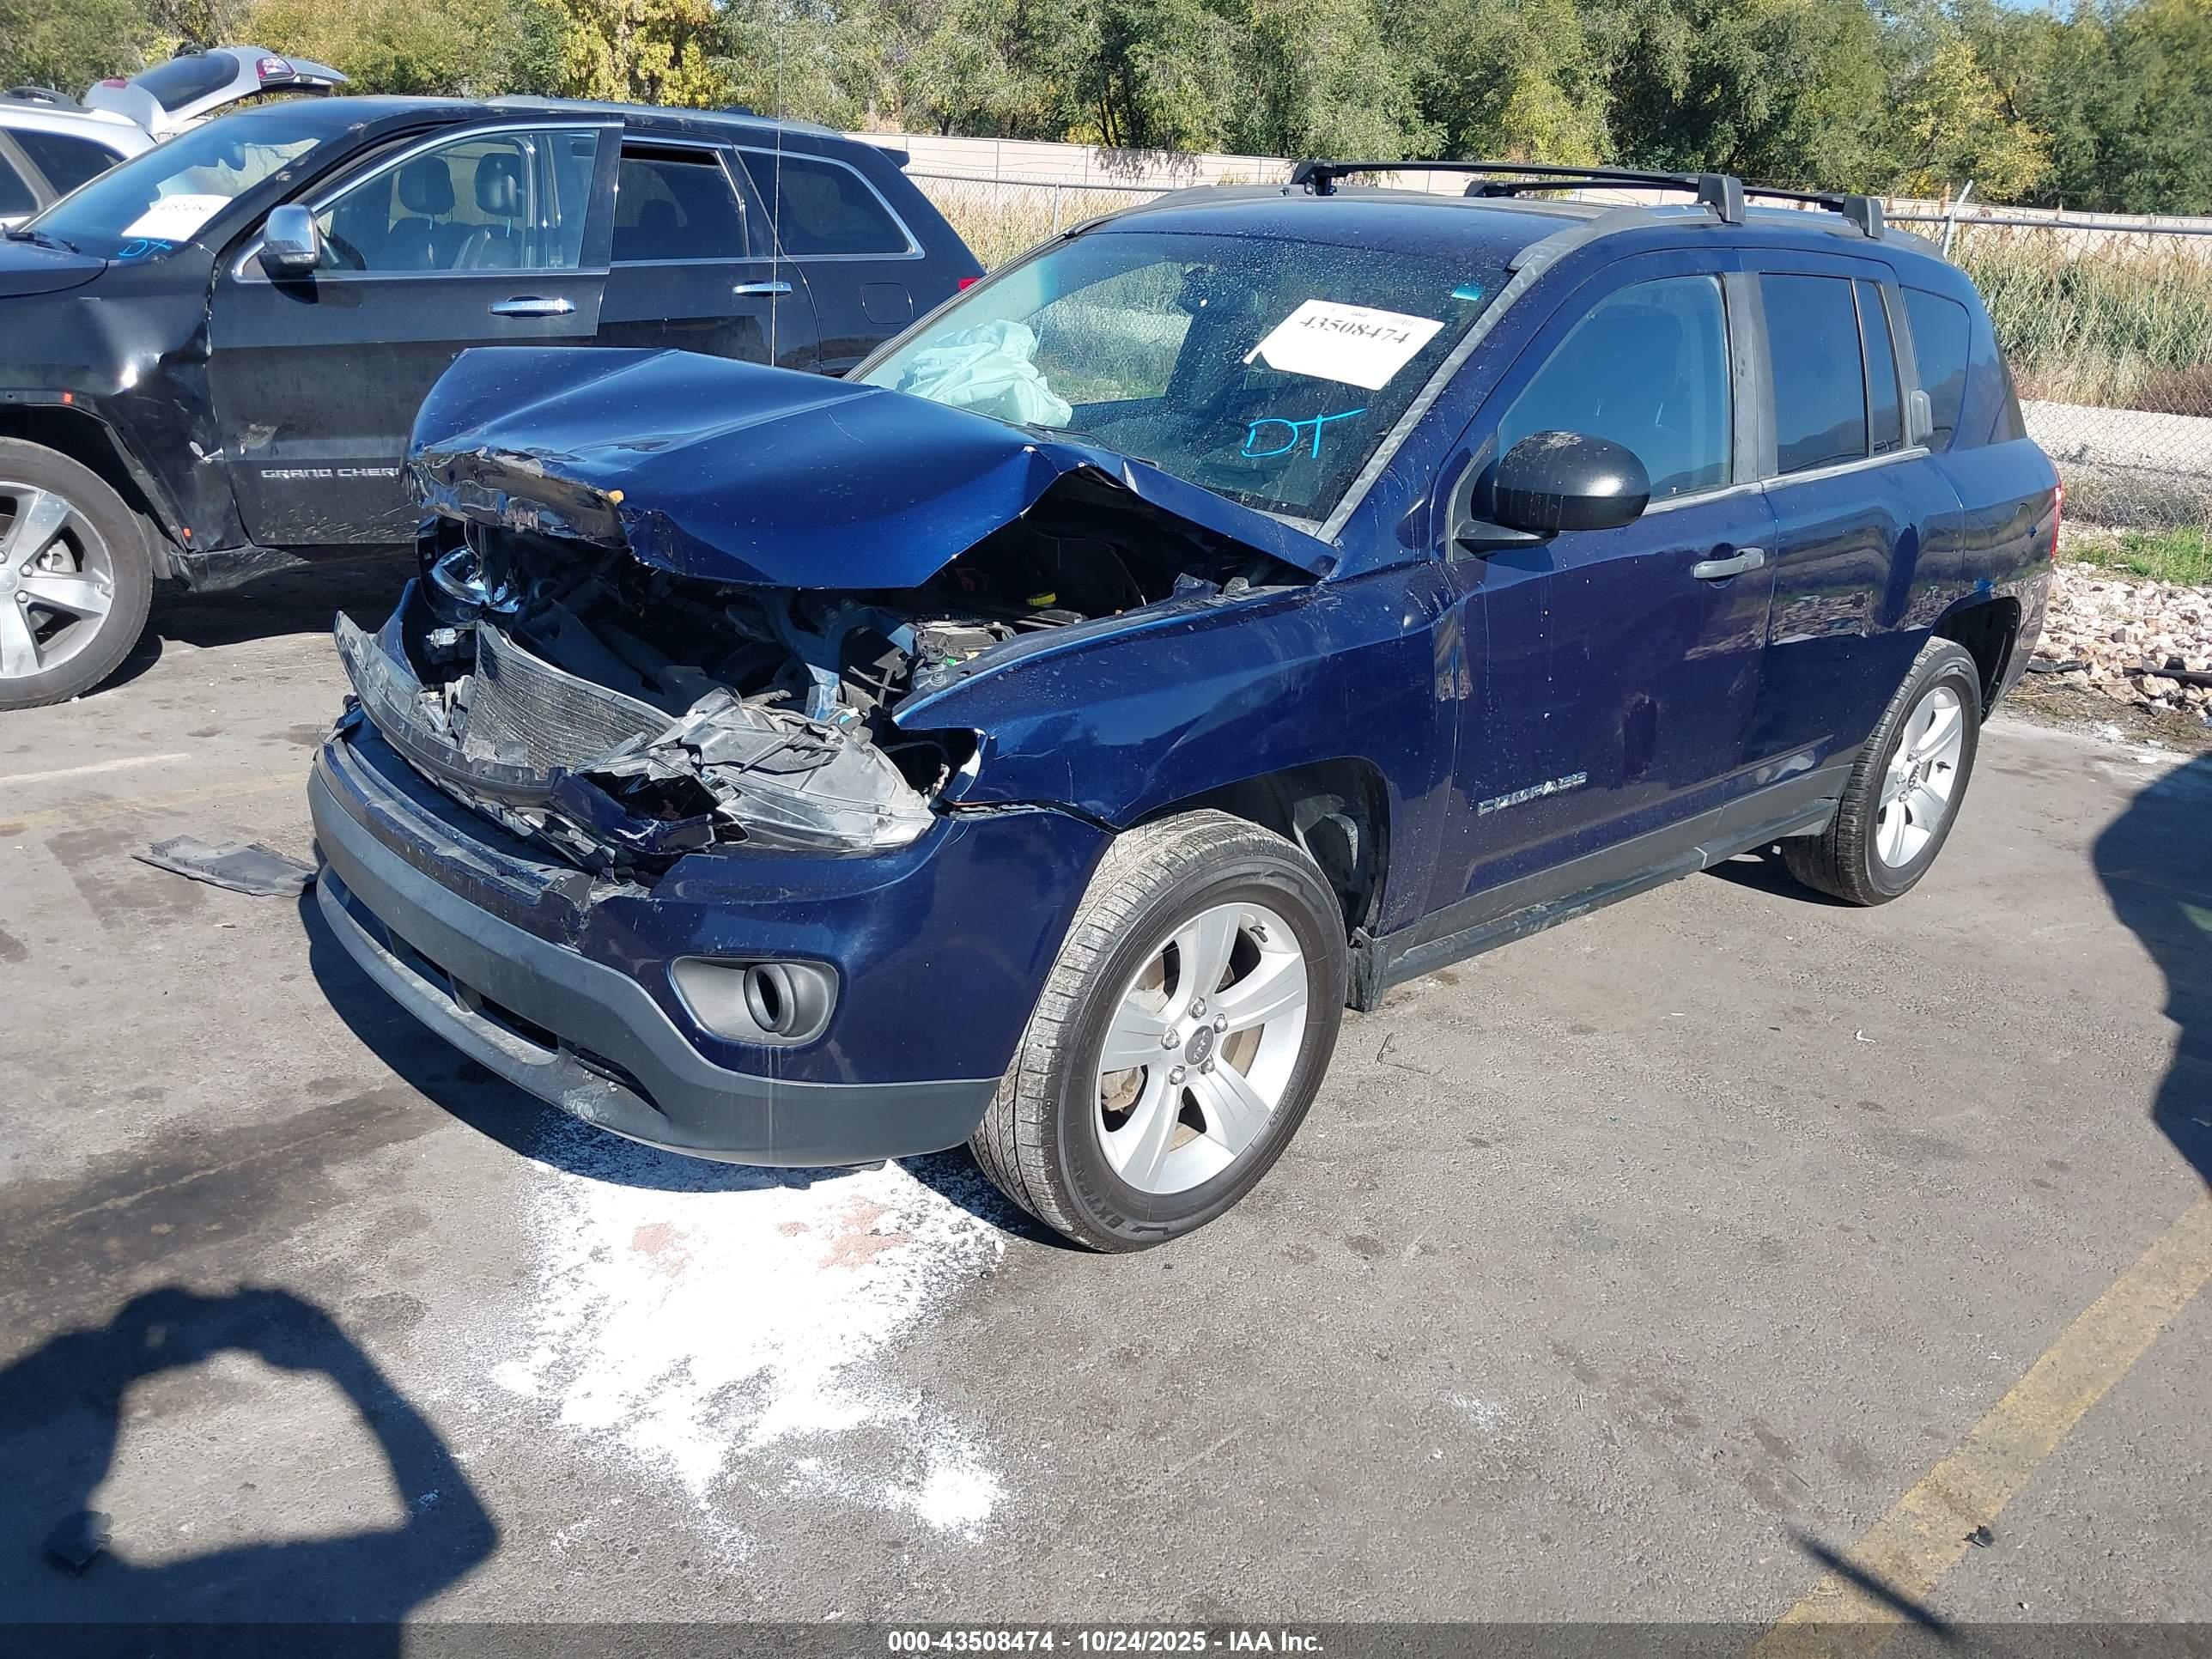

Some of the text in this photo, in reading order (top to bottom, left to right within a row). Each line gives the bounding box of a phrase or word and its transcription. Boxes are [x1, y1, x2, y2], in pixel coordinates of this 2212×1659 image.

[1300, 315, 1411, 343] 43508474
[1241, 408, 1368, 459] DT
[260, 468, 333, 479] GRAND
[1477, 771, 1588, 816] COMPASS
